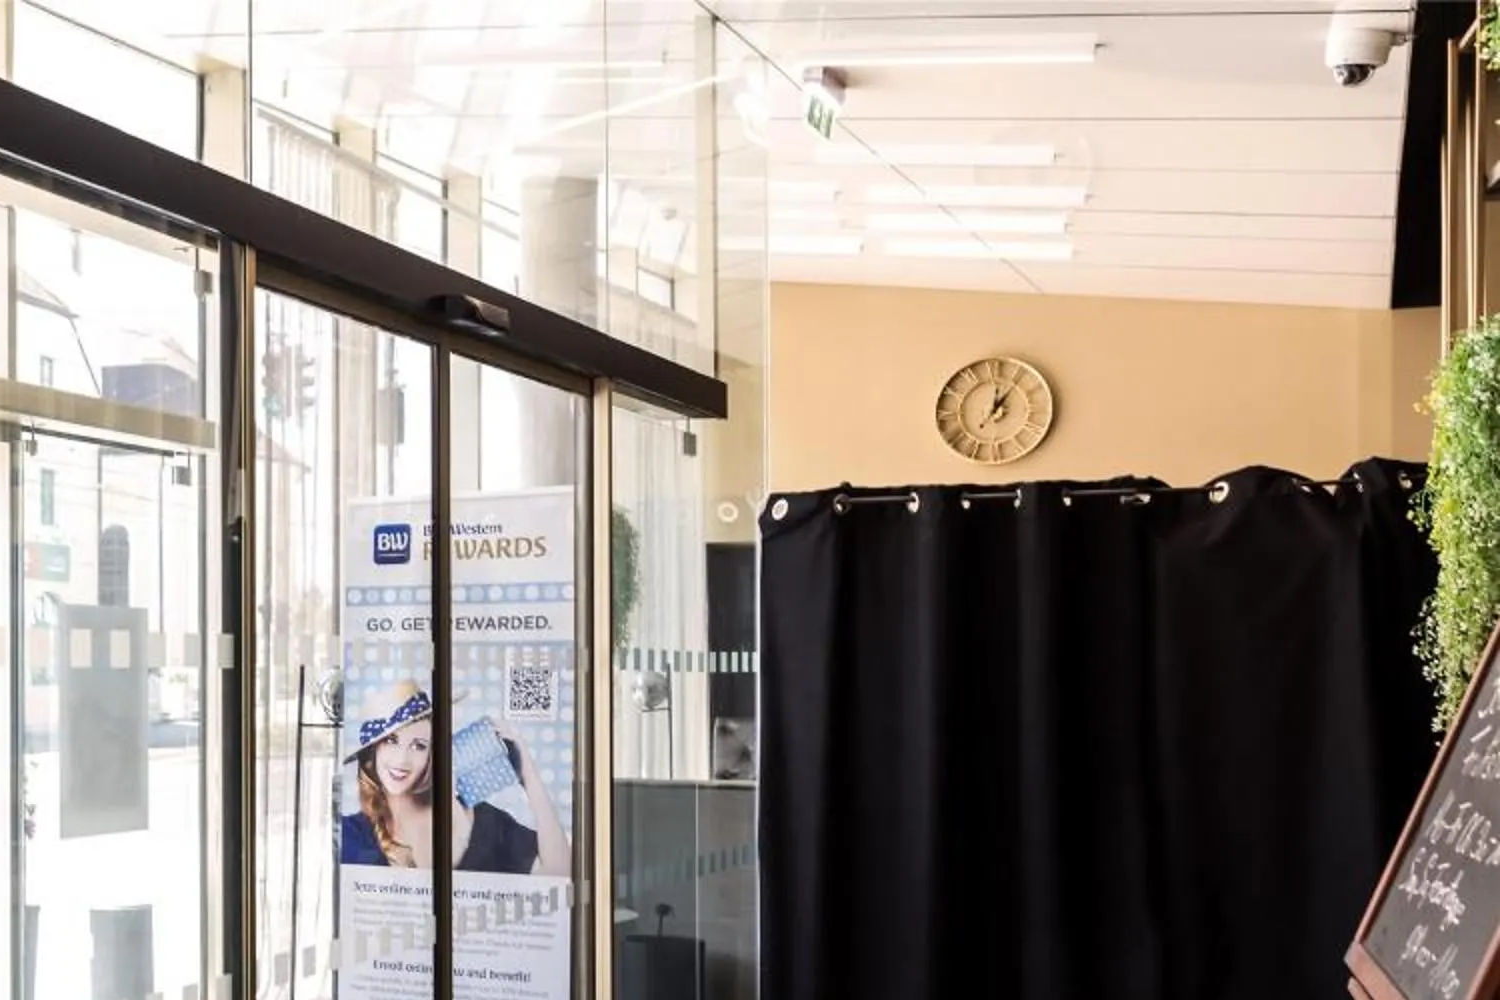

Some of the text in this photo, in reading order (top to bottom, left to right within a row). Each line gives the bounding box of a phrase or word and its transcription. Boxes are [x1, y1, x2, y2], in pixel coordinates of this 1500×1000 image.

[377, 532, 408, 551] BW
[424, 536, 547, 560] RWARDS
[367, 618, 396, 632] GO.
[450, 615, 551, 631] EWARDED.
[405, 962, 433, 974] onlin
[467, 968, 486, 979] and
